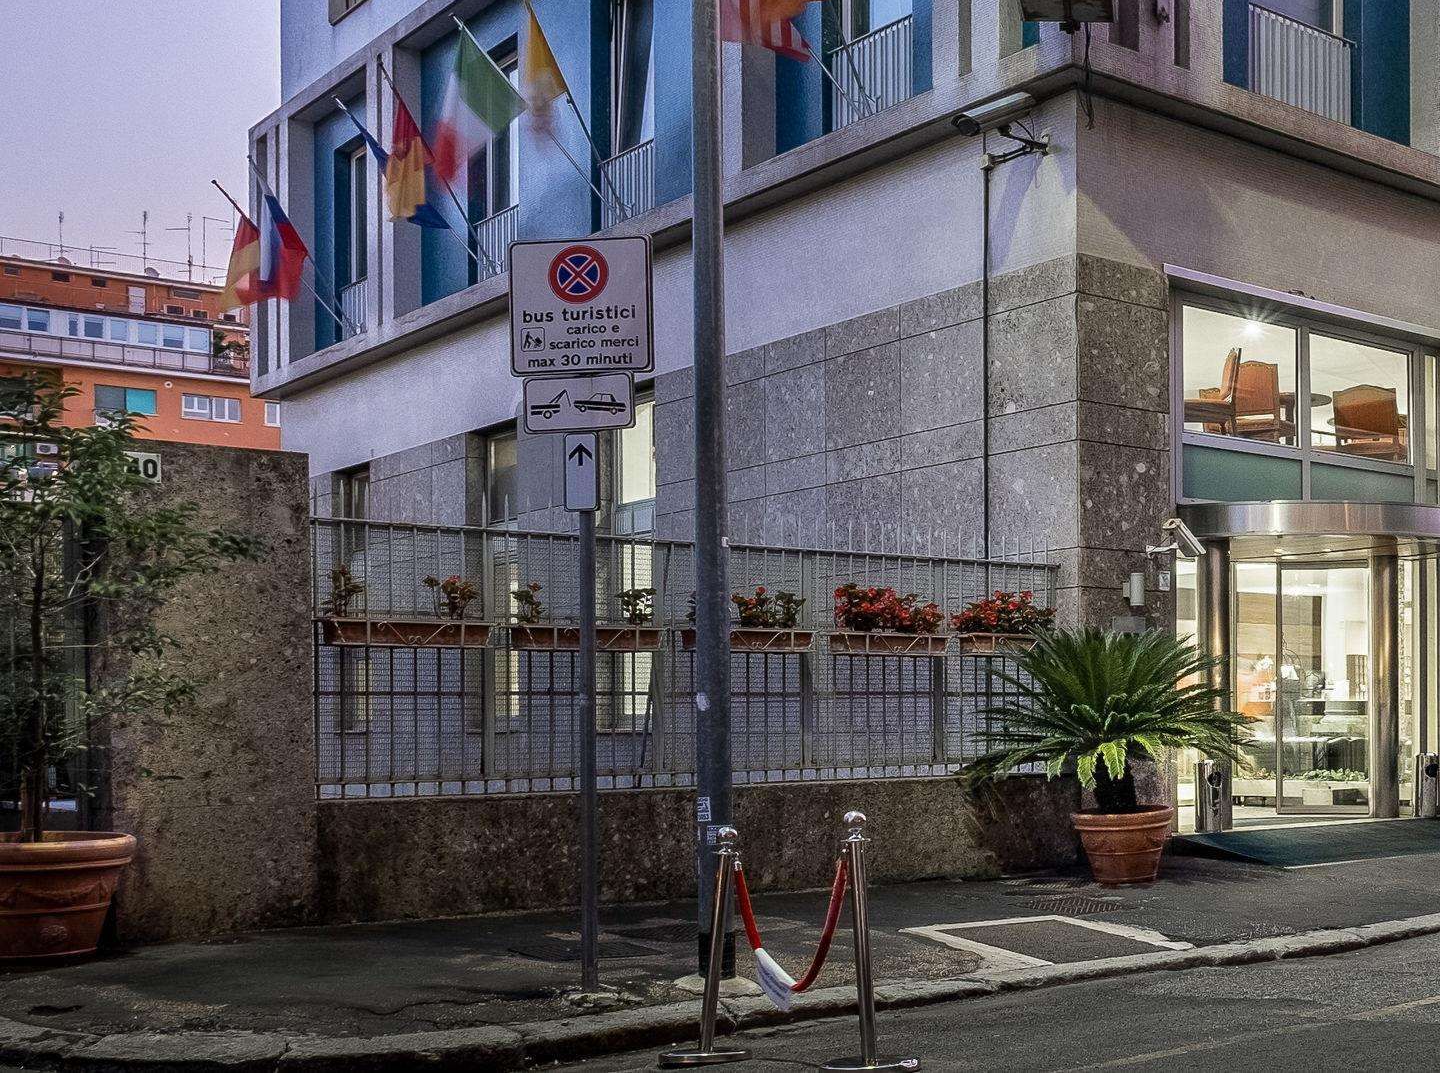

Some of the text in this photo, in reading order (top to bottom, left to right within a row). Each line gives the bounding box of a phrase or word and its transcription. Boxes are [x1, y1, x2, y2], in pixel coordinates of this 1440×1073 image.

[522, 305, 636, 323] bus turistici
[566, 324, 620, 335] carico e
[549, 335, 639, 350] scarico merci
[527, 352, 633, 368] max 30 minuti
